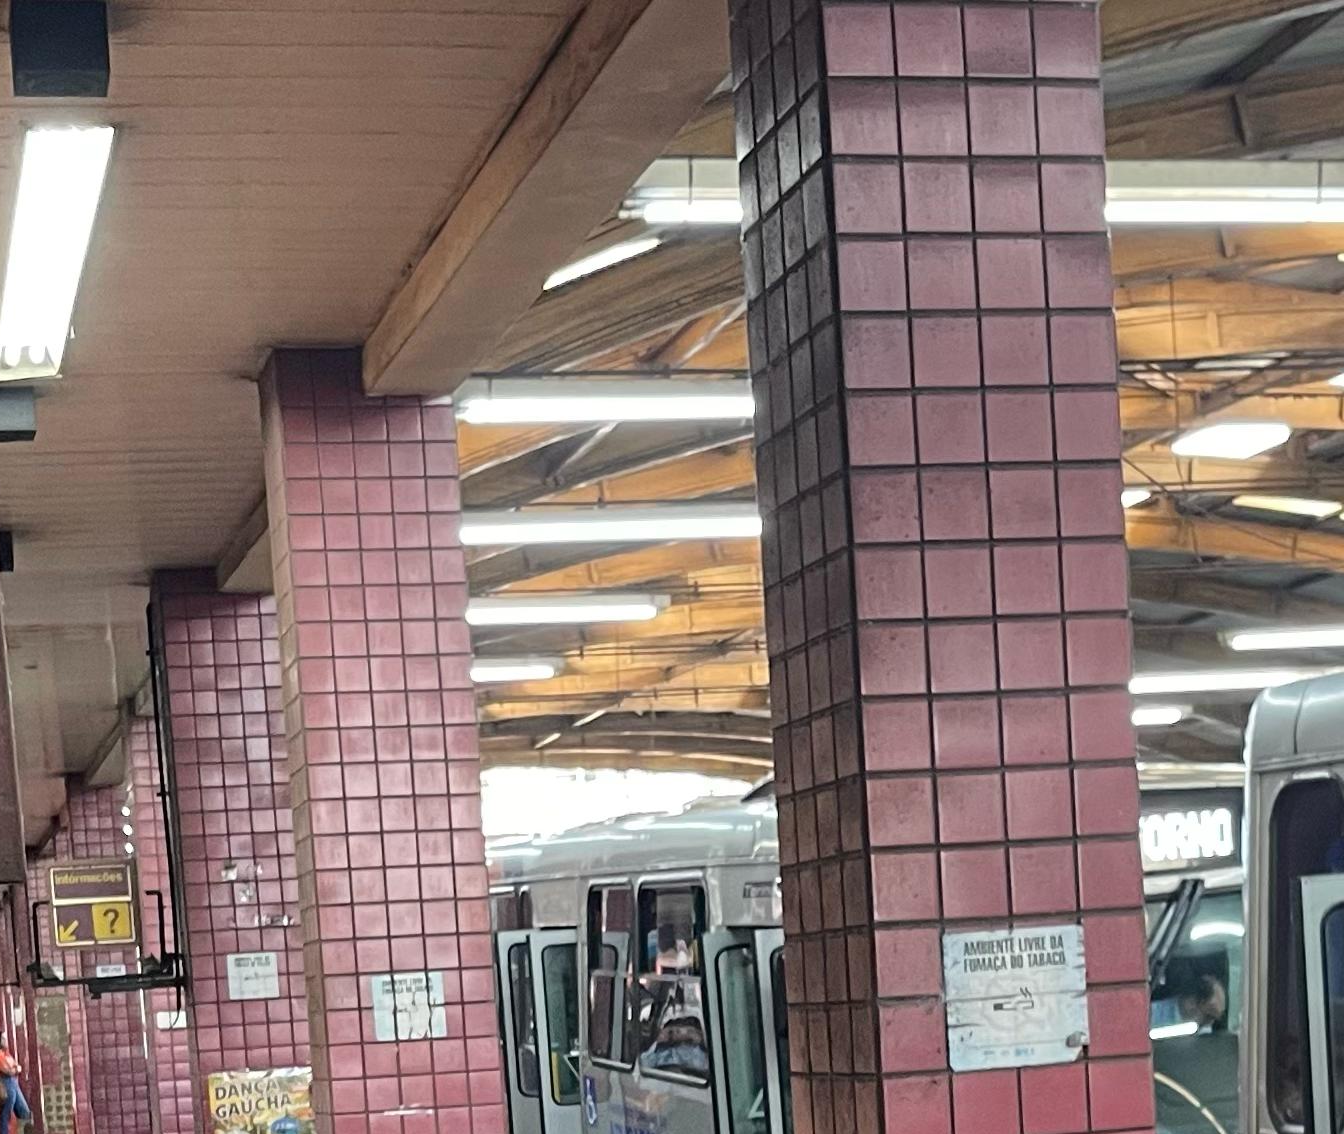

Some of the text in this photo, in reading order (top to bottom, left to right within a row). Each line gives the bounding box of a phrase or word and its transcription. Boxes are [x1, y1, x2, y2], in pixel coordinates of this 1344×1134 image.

[1139, 808, 1234, 862] ORNO
[963, 934, 1065, 957] AMBIENTE LIVRE DA
[963, 951, 1067, 973] FUMAÇA DO TABACO
